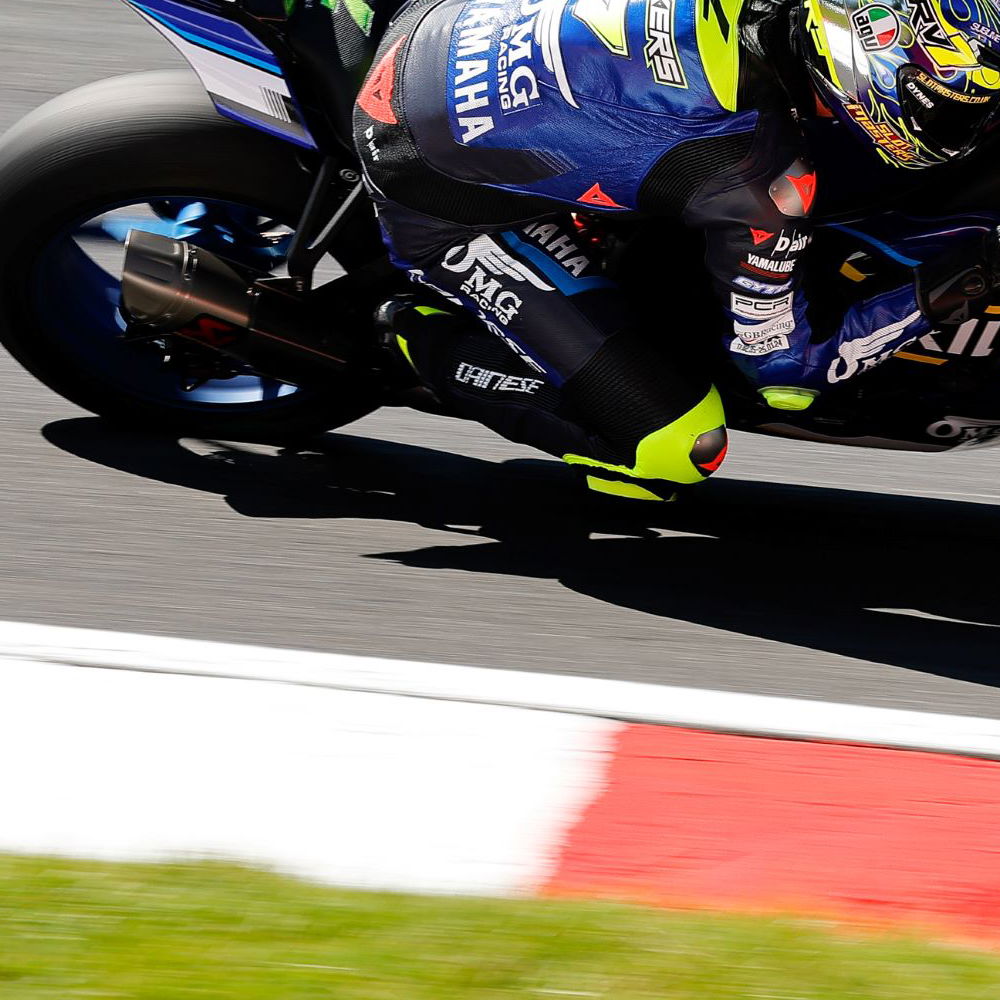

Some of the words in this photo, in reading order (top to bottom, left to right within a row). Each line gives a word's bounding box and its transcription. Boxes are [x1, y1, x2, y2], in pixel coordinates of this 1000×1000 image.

[855, 13, 879, 49] agv
[498, 26, 512, 110] RACING
[906, 81, 935, 110] DYNES
[521, 222, 591, 278] AHA
[747, 253, 797, 273] YAMALUBE
[441, 234, 545, 321] OMG
[459, 283, 509, 326] RACING
[735, 296, 790, 311] PCR
